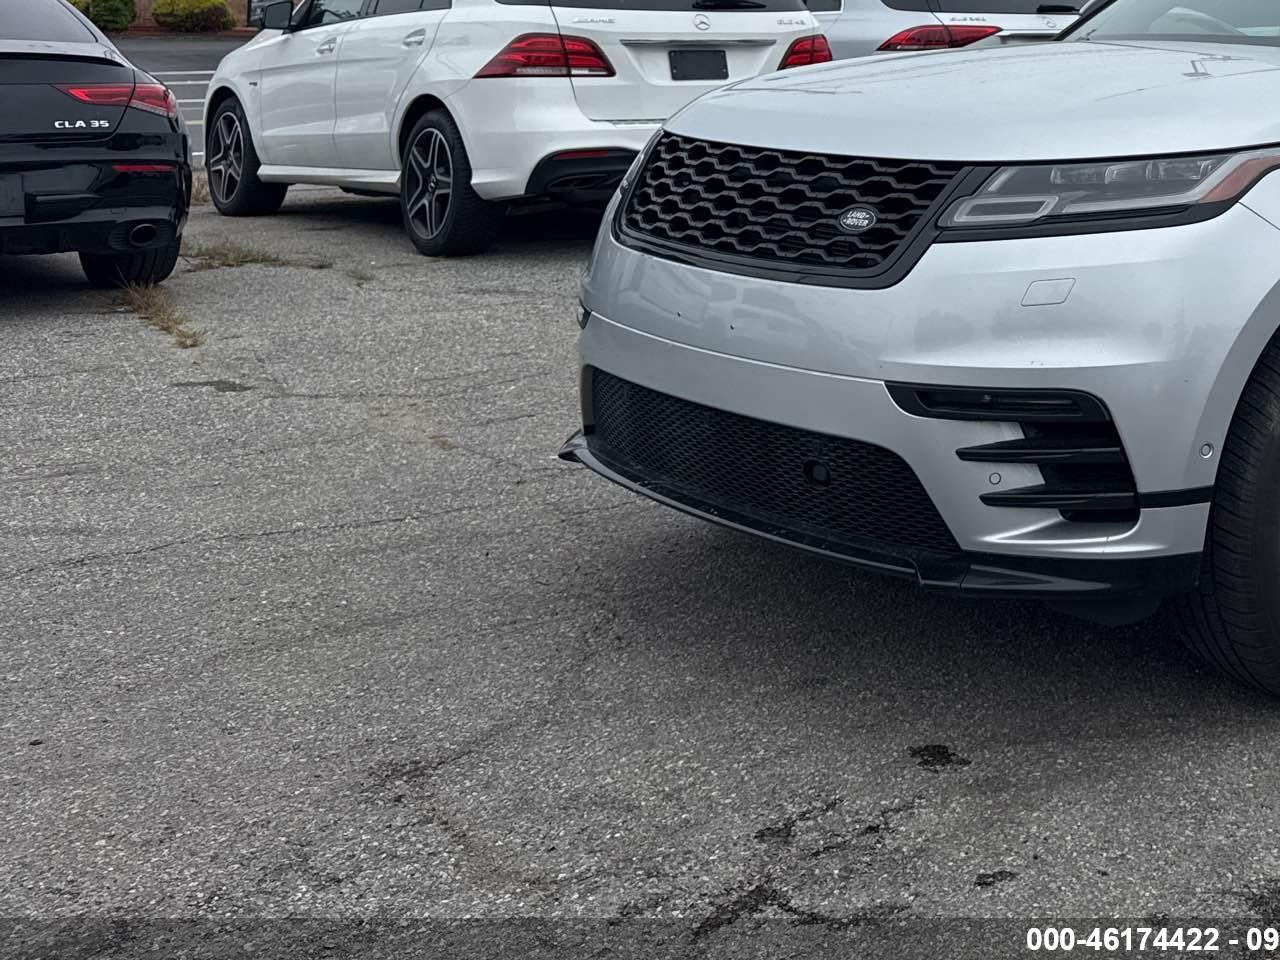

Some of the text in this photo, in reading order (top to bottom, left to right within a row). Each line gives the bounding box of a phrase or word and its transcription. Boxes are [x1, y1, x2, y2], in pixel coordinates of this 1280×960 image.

[54, 120, 110, 129] CLA 35
[847, 210, 867, 219] LAND
[845, 218, 869, 227] ROVER
